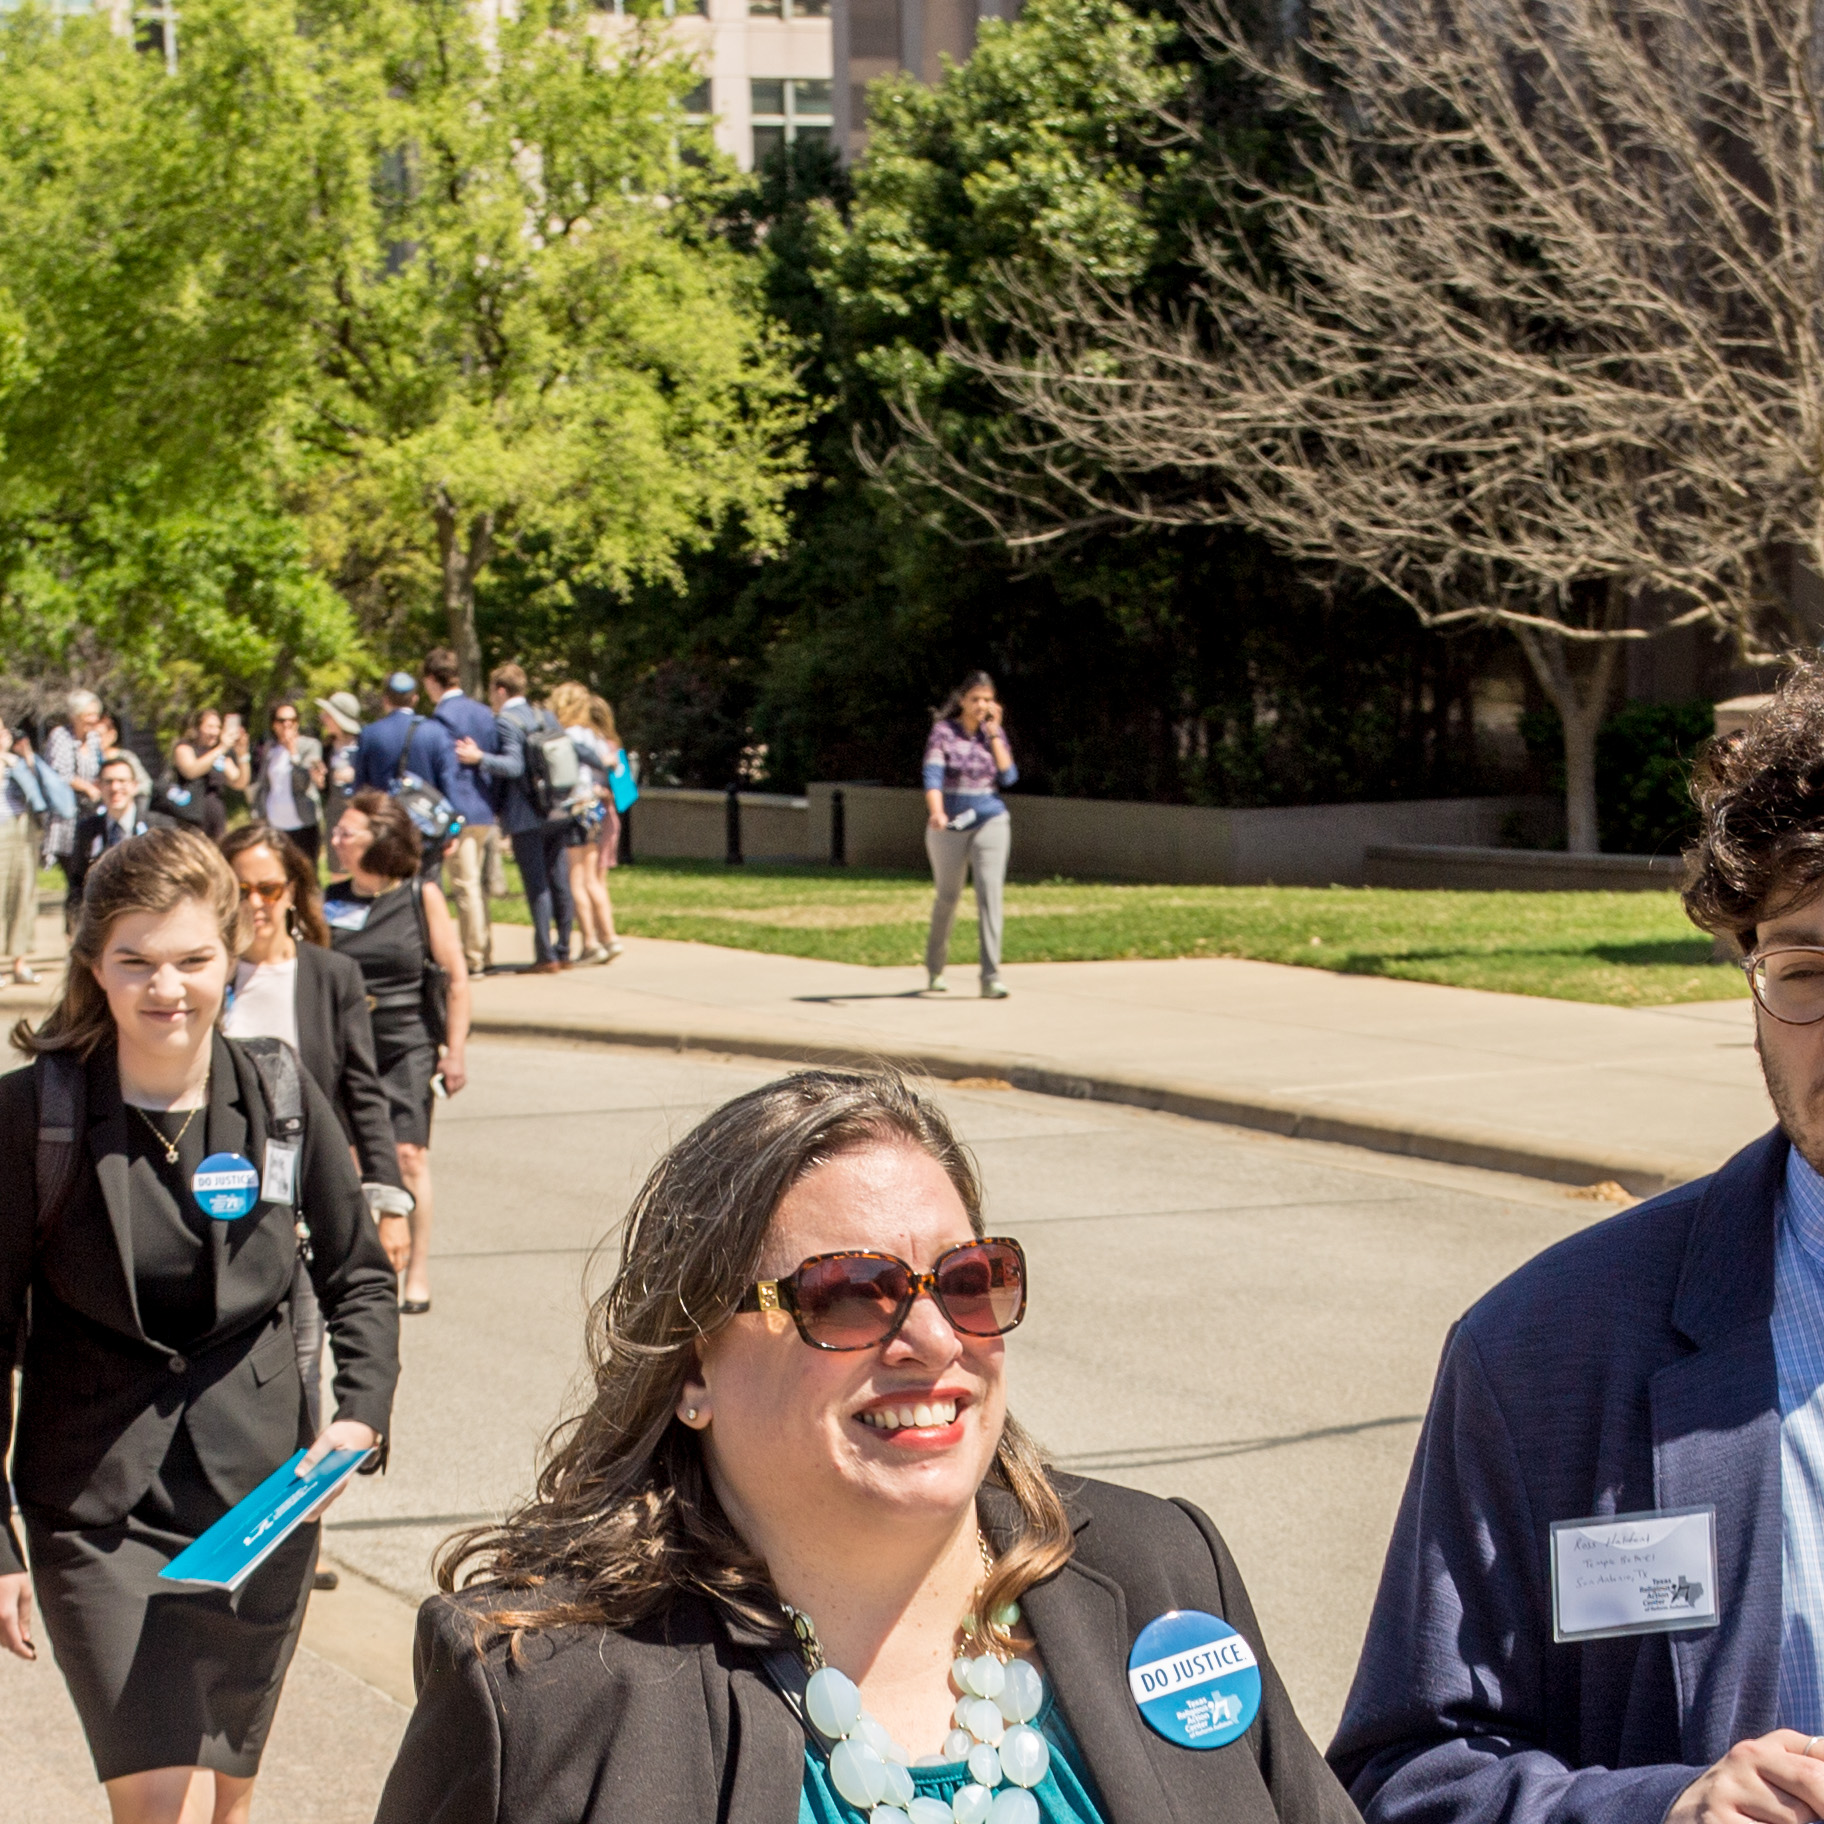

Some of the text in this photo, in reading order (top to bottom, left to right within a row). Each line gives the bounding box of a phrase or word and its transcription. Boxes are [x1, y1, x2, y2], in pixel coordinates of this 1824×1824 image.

[198, 1177, 212, 1187] DO
[1141, 1643, 1247, 1692] DO JUSTICE.
